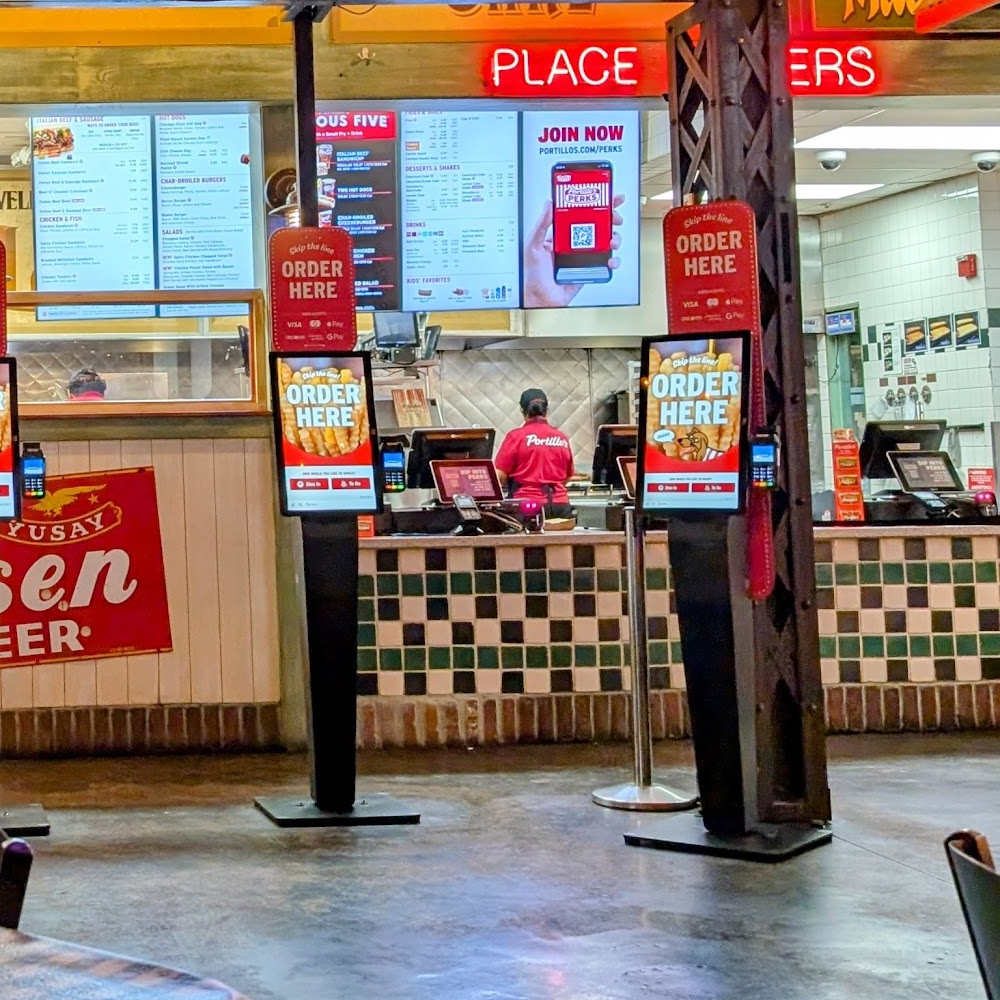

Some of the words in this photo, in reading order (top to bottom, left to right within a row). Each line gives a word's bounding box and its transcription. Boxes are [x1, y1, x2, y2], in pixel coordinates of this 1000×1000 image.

[492, 46, 639, 87] PLACE
[315, 114, 348, 128] OUS
[353, 114, 389, 128] FIVE
[538, 126, 579, 143] JOIN
[584, 125, 624, 142] NOW
[539, 145, 623, 156] PORTILLOS.COM/PERKS
[568, 194, 597, 203] PERKS
[684, 216, 701, 228] Skip
[702, 212, 717, 221] the
[717, 213, 734, 225] line
[289, 244, 306, 256] Skip
[306, 242, 320, 250] the
[320, 243, 335, 255] line
[676, 230, 743, 254] ORDER
[281, 260, 344, 278] ORDER
[684, 253, 737, 277] HERE
[289, 281, 338, 299] HERE
[682, 301, 699, 309] VISA
[286, 383, 361, 405] ORDER
[651, 371, 739, 399] ORDER
[296, 406, 355, 428] HERE
[659, 399, 729, 427] HERE
[525, 432, 569, 449] Portillo's
[6, 512, 104, 542] YUSAY
